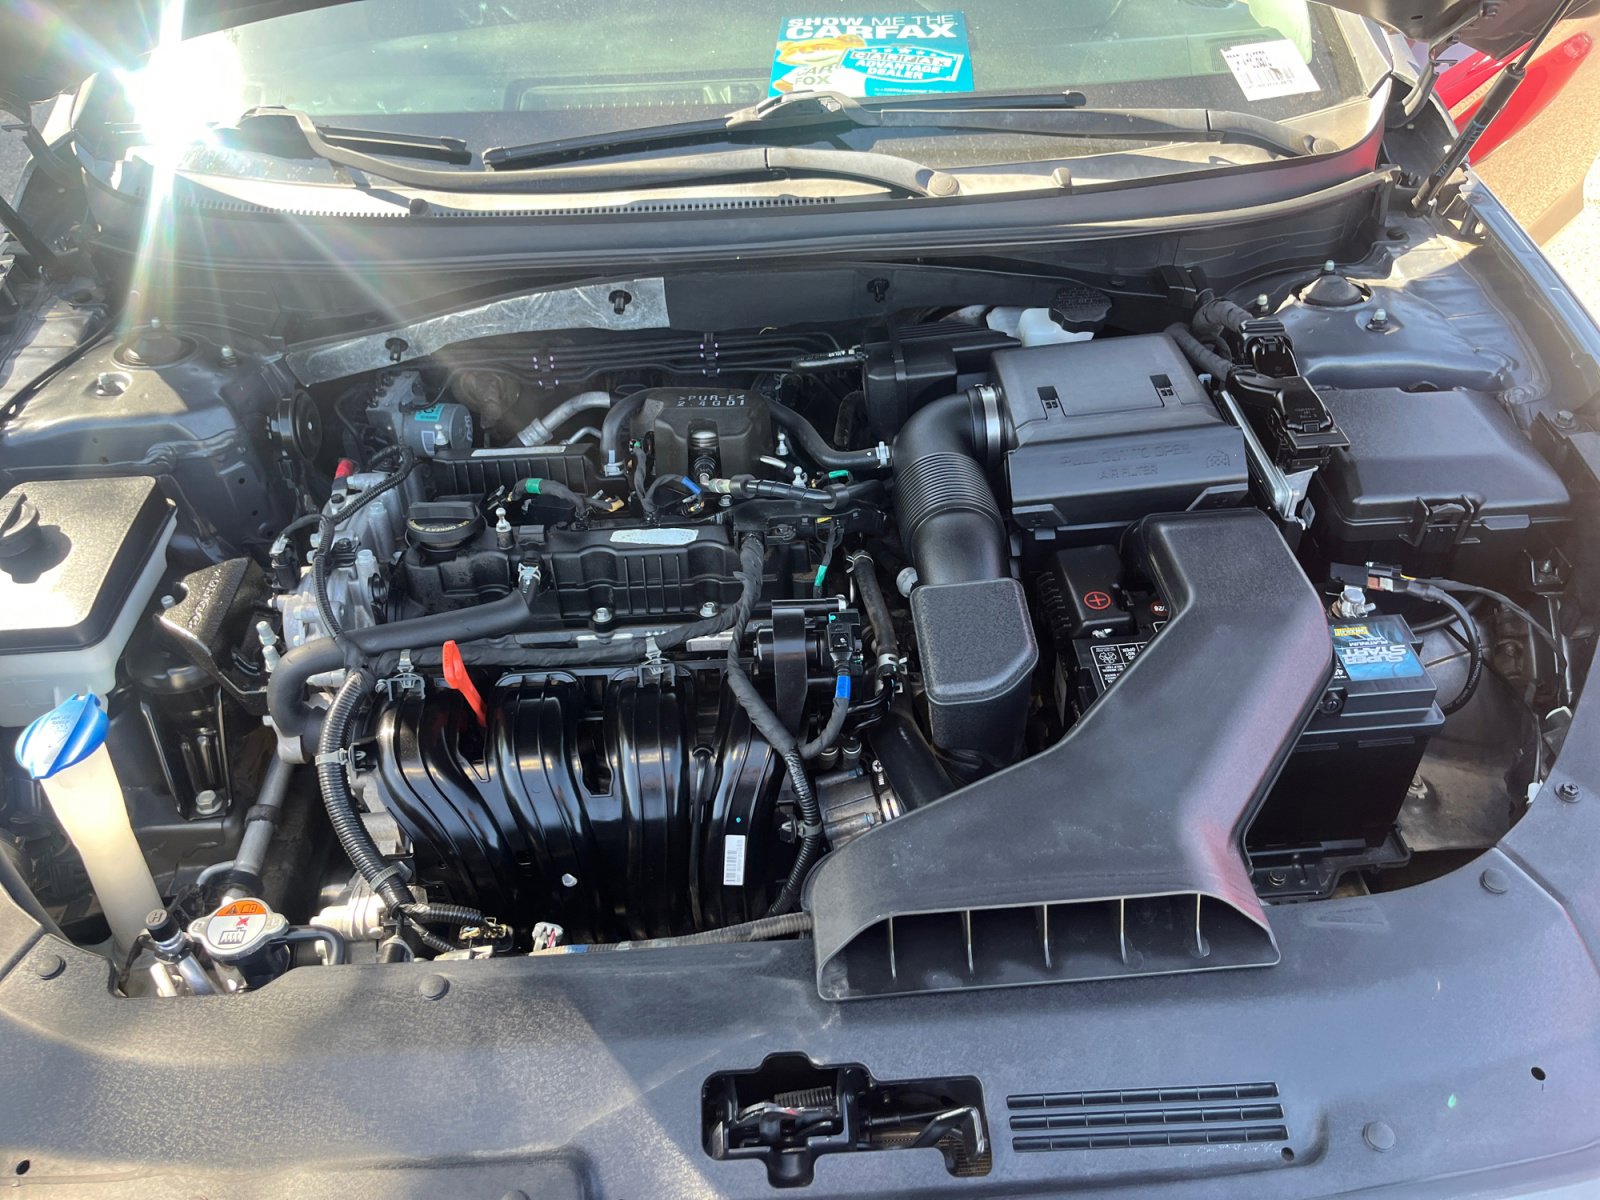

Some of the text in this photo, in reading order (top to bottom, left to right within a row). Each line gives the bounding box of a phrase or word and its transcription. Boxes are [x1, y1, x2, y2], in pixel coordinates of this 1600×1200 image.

[787, 15, 954, 27] SHOW ME THE
[787, 25, 957, 39] CARFAX
[796, 65, 833, 76] CAR
[855, 60, 941, 74] ADVANTAGE
[866, 68, 924, 80] DEALER
[795, 75, 832, 86] FOX
[1342, 644, 1407, 657] START
[1344, 653, 1404, 665] SUPER
